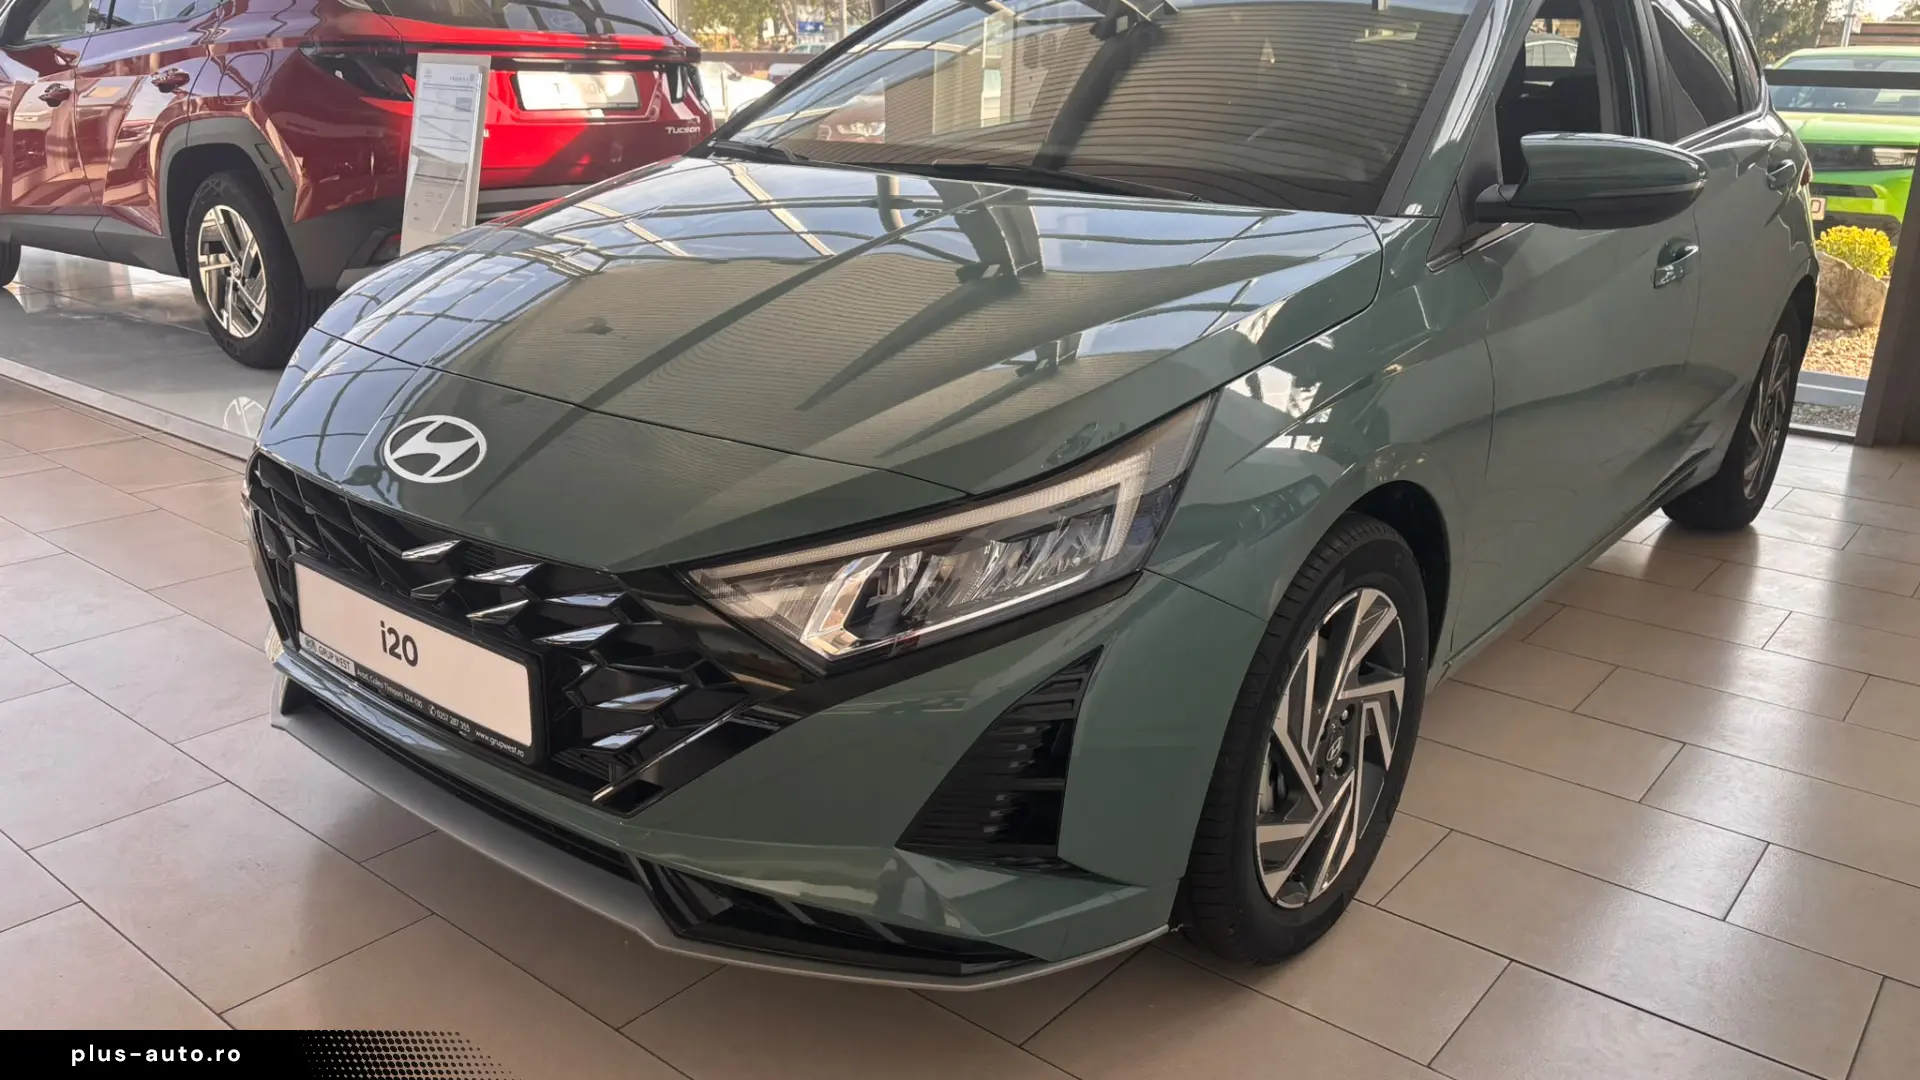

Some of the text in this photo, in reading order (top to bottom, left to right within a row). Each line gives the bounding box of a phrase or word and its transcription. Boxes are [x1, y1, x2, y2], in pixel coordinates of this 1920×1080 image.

[665, 126, 700, 134] Tucson
[380, 620, 419, 668] i20
[318, 645, 350, 671] GRUP WEST
[475, 730, 525, 758] www.grupwest.ro
